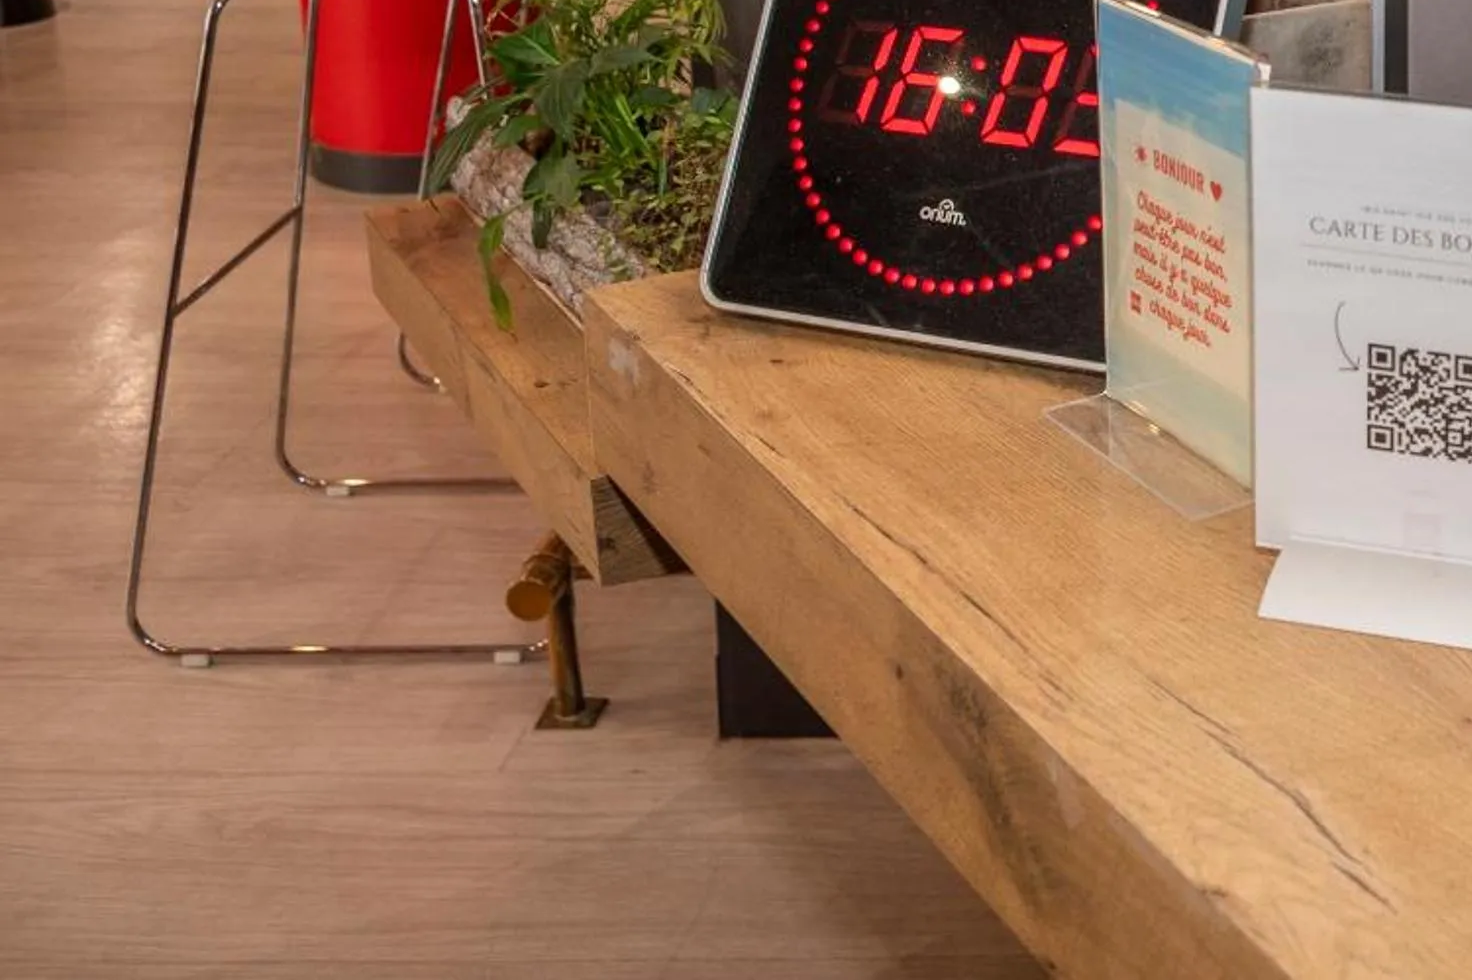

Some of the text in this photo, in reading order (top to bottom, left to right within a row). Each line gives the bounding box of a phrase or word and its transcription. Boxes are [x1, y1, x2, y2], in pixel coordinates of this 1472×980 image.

[1152, 149, 1205, 194] BONJOUR
[1137, 190, 1225, 254] Chaque jour n'est
[1308, 215, 1386, 243] CARTE
[1391, 224, 1434, 249] DES
[1134, 242, 1158, 266] mais
[1168, 263, 1179, 286] y
[1190, 275, 1232, 309] quelque
[1181, 244, 1201, 267] pas
[1135, 266, 1230, 334] chose de bon dans
[1149, 298, 1186, 331] chaque
